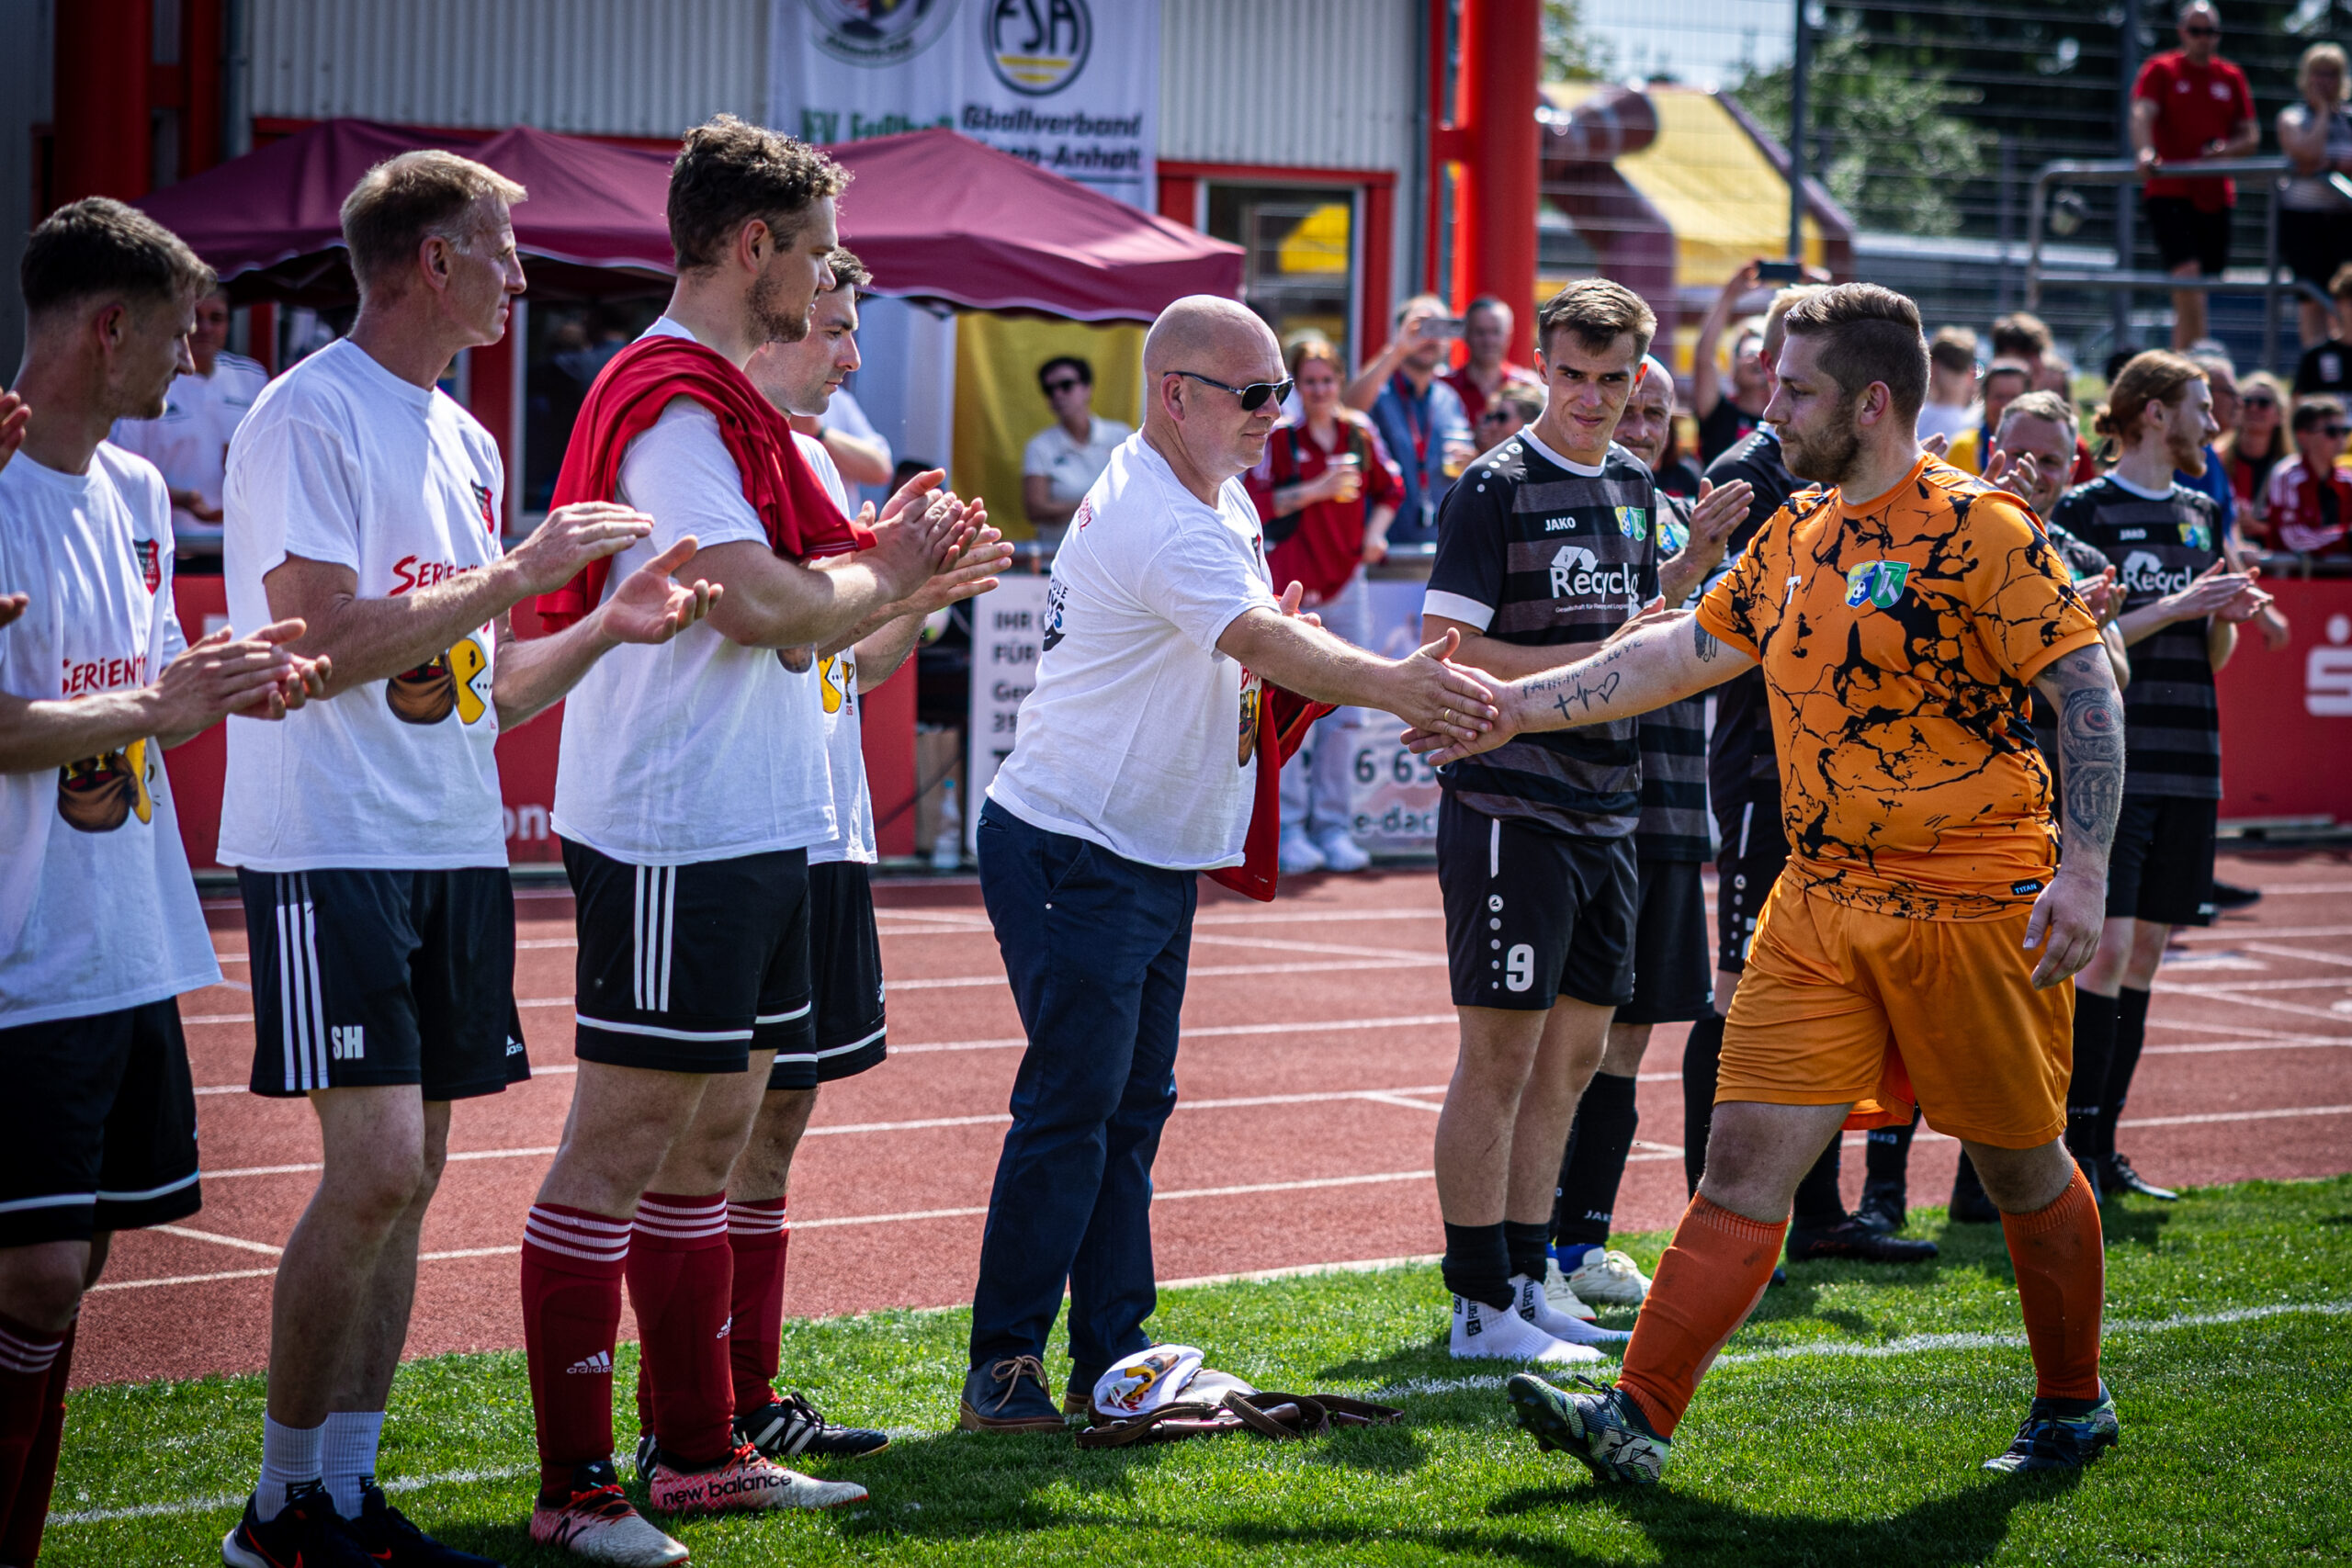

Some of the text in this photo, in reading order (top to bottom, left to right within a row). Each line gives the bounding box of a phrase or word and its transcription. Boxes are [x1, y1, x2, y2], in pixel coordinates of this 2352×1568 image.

[1545, 516, 1577, 532] JAKO
[2015, 883, 2038, 894] TITAN
[1506, 942, 1535, 992] 9
[331, 1025, 365, 1060] SH
[566, 1365, 614, 1374] adidas
[662, 1473, 793, 1506] new balance
